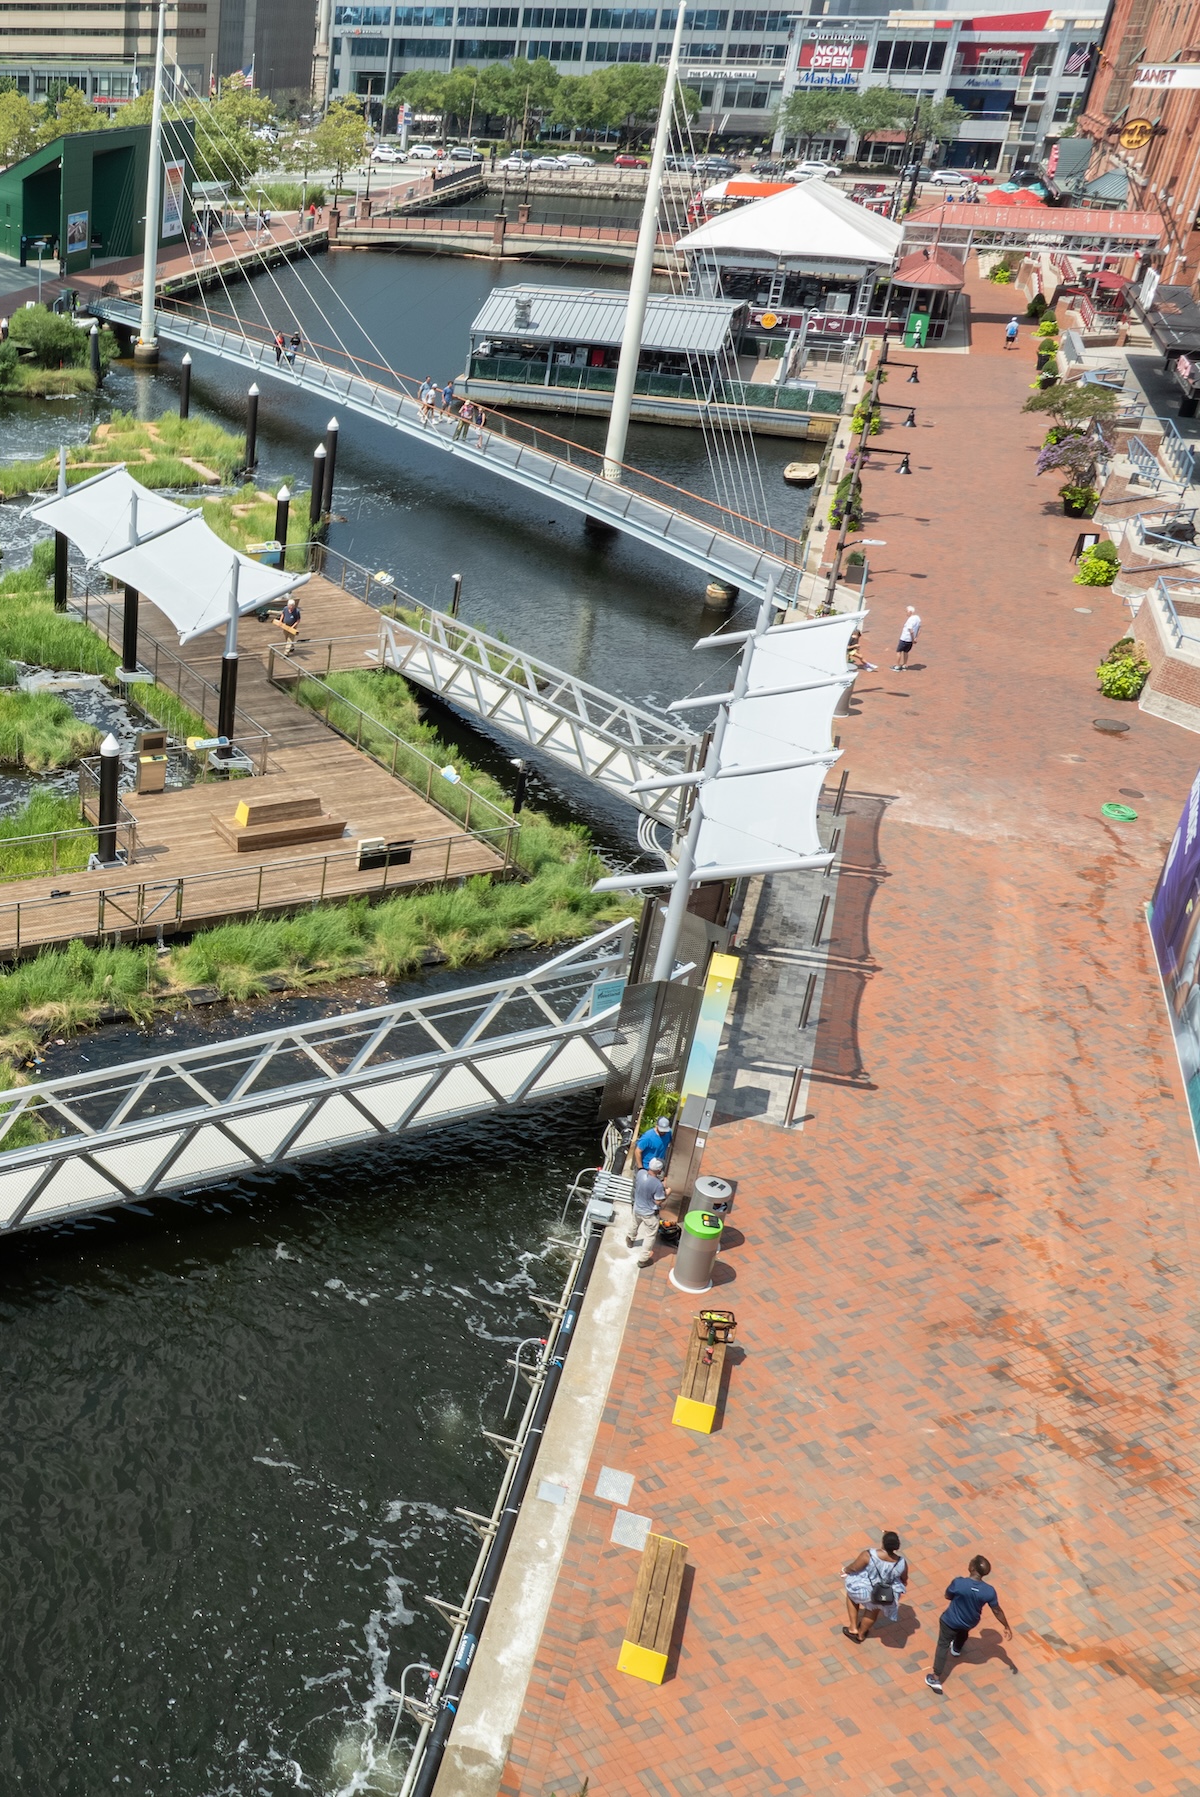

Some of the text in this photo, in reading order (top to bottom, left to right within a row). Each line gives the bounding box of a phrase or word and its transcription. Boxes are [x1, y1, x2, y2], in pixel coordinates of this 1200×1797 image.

[808, 30, 867, 43] Burlington
[816, 45, 852, 56] NOW
[810, 56, 854, 67] OPEN
[800, 72, 857, 85] Marshalls
